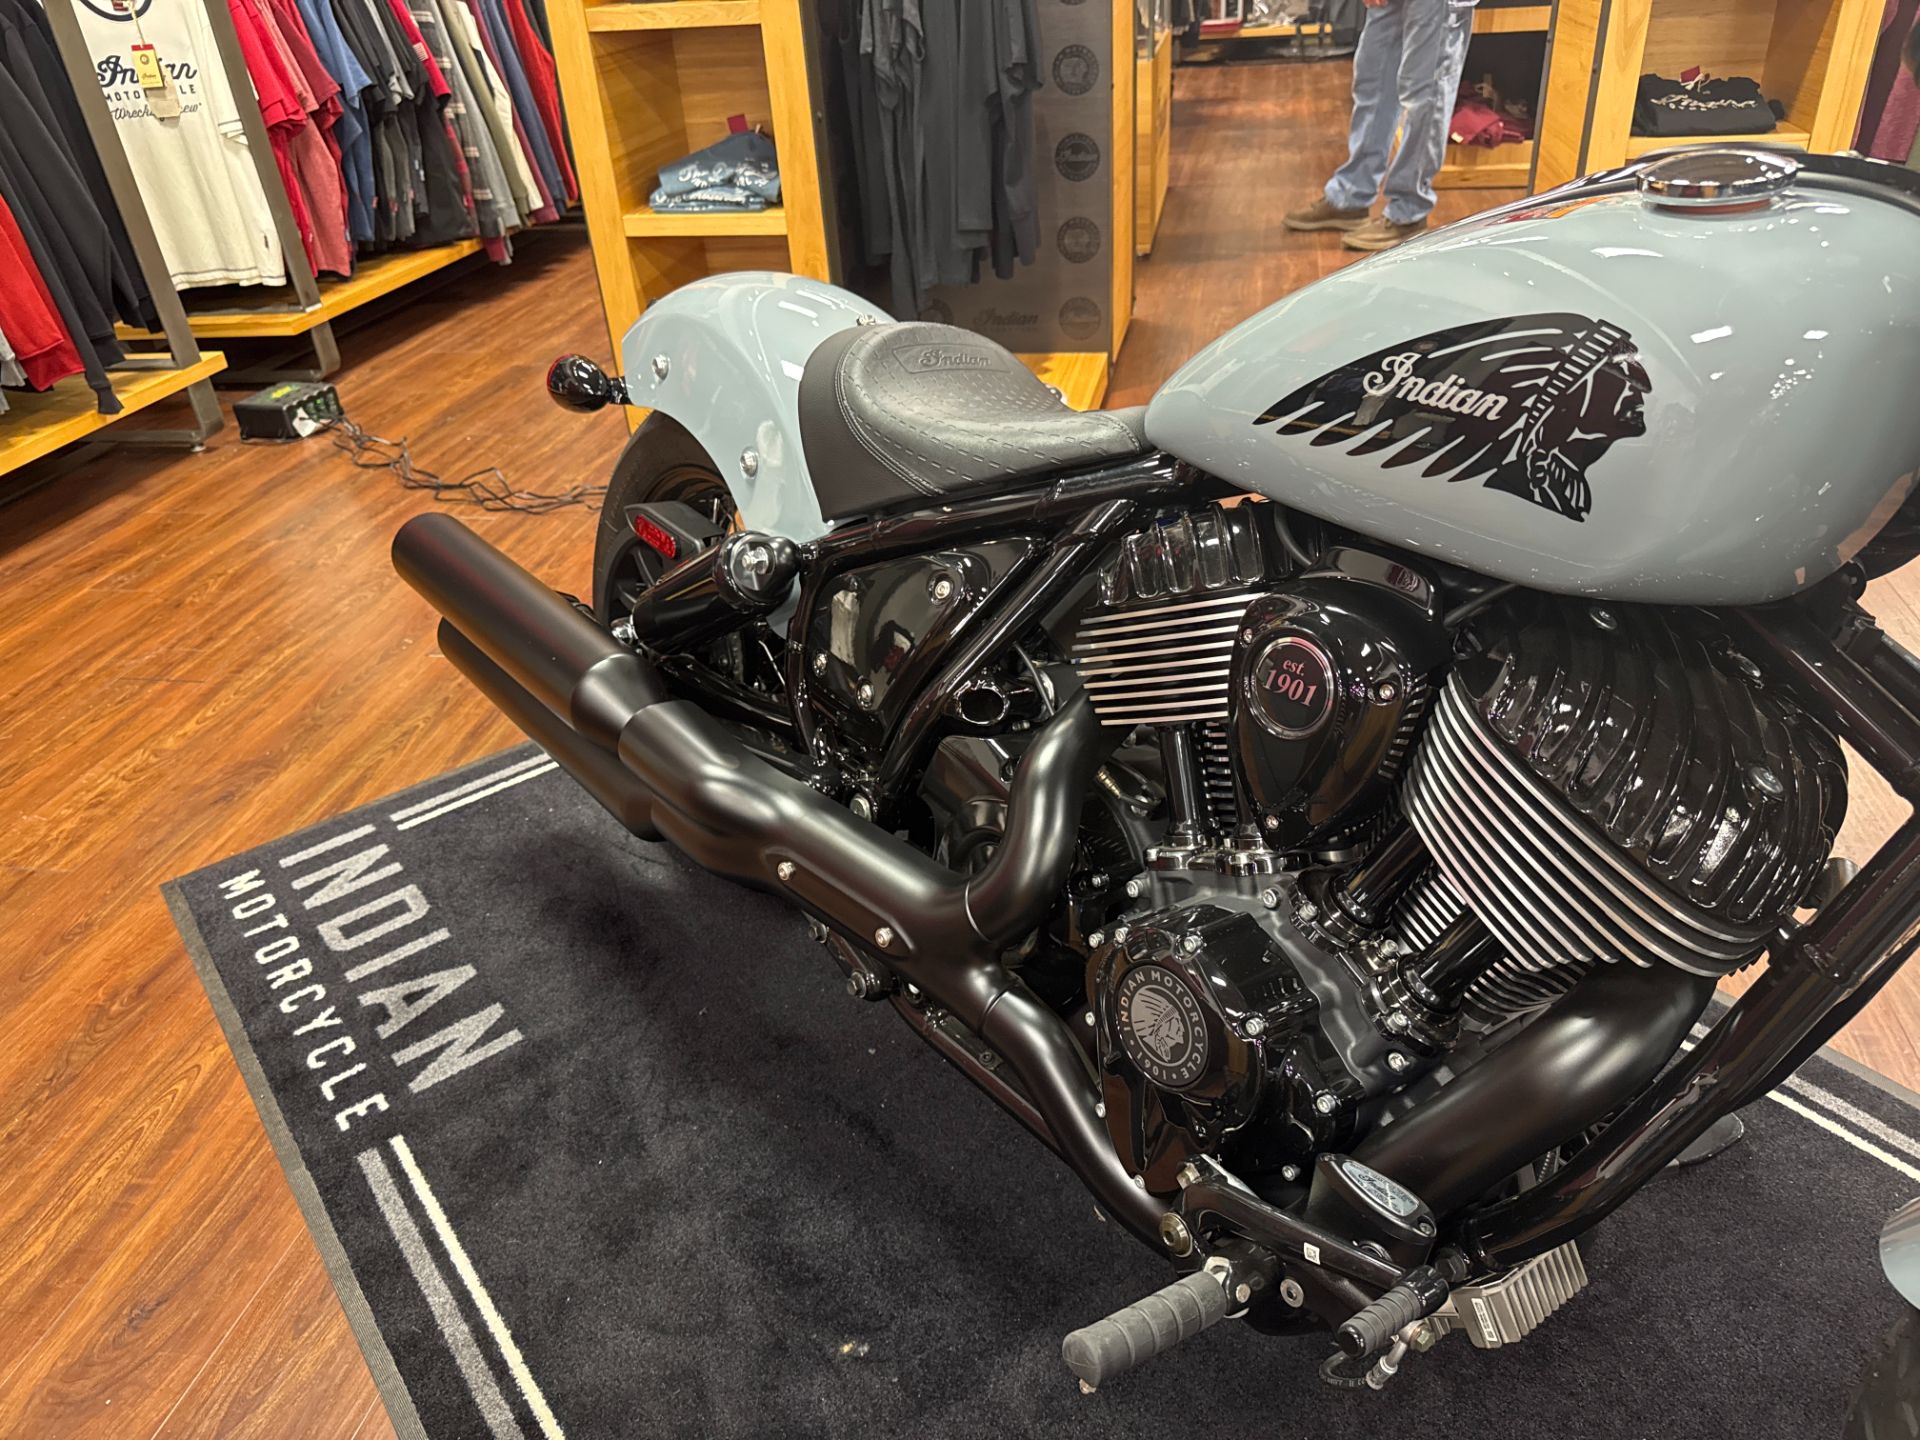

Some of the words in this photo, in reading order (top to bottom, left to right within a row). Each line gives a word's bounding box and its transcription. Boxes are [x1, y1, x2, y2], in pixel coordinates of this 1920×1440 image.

[919, 349, 991, 368] Indian
[1362, 352, 1509, 421] Indian
[1262, 669, 1317, 707] 1901
[1282, 659, 1305, 677] est.
[278, 823, 524, 1094] INDIAN
[218, 868, 391, 1133] MOTORCYCLE
[1120, 970, 1146, 1032] INDIAN
[1151, 970, 1205, 1080] MOTORCYCLE
